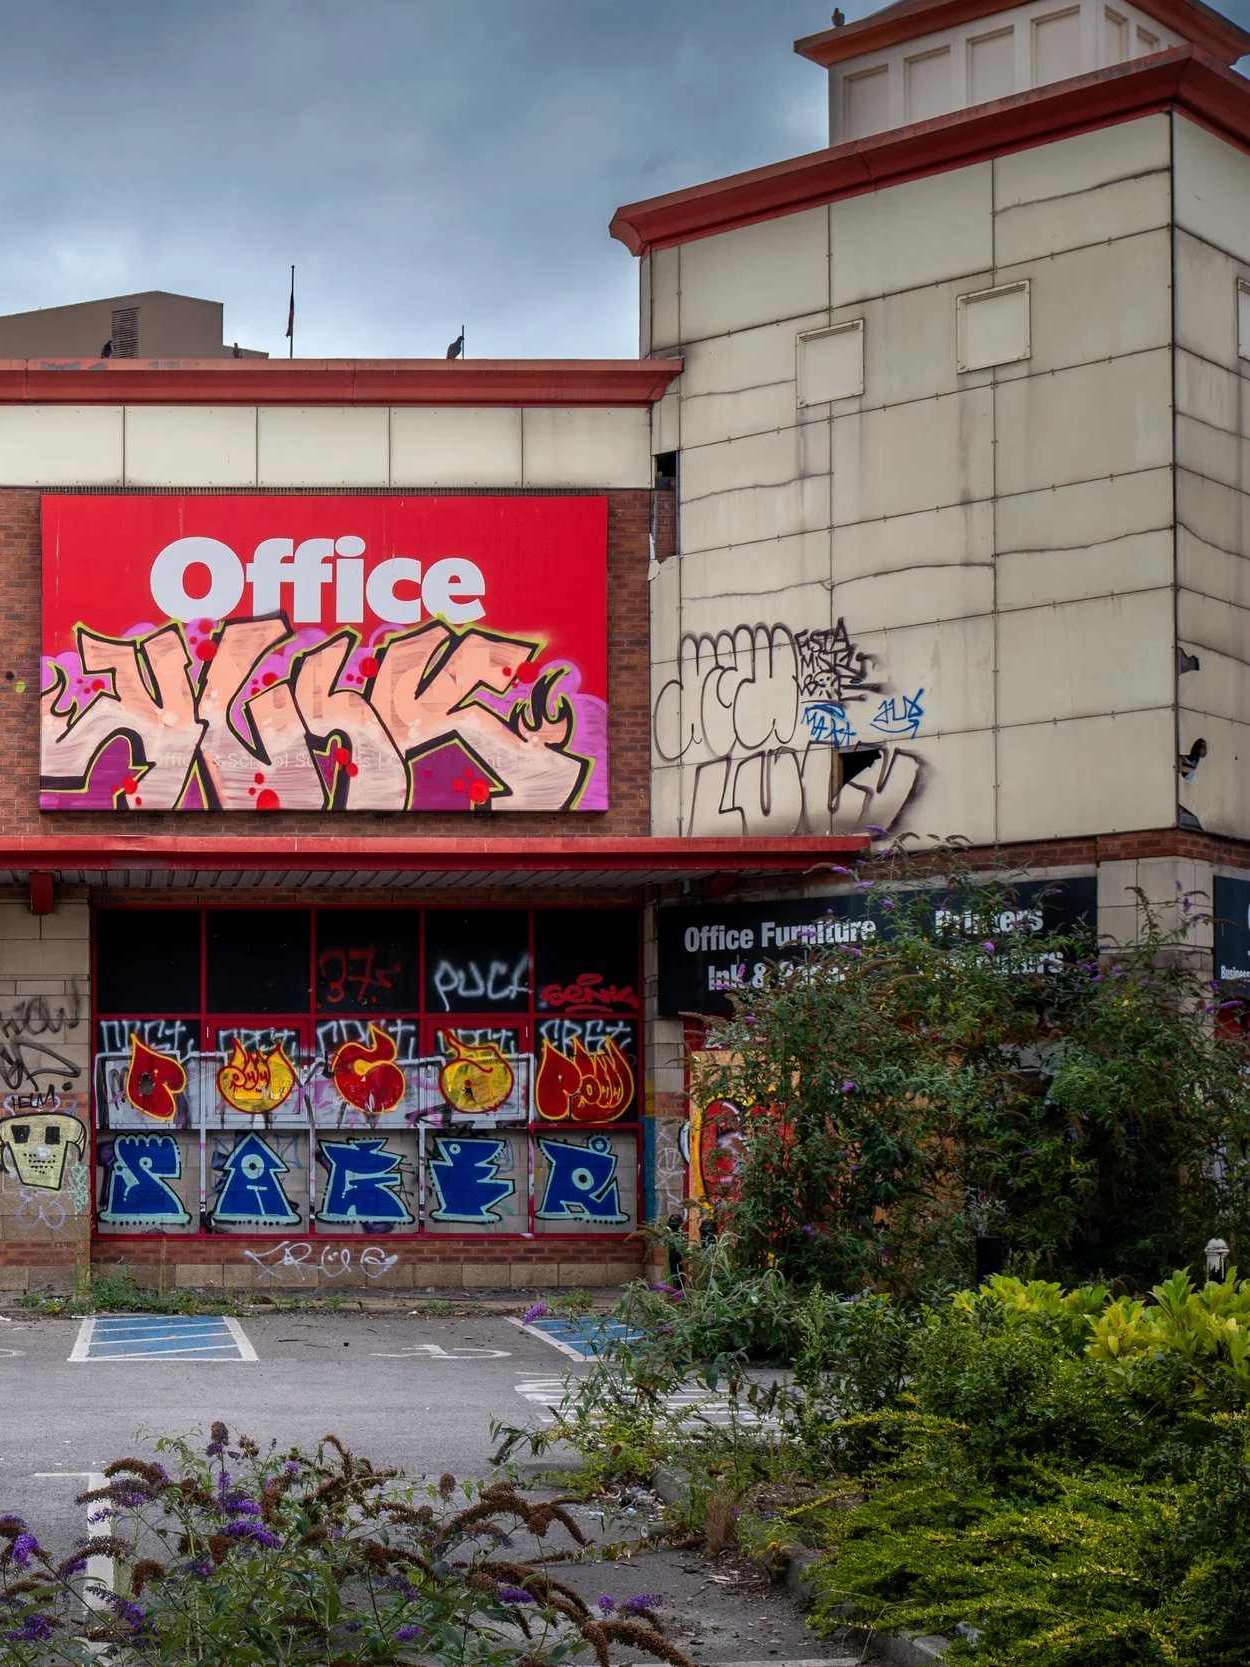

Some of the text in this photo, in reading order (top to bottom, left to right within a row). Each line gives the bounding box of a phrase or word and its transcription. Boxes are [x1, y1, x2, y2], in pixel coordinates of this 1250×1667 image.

[150, 535, 486, 624] Office
[684, 920, 876, 952] Office Furniture
